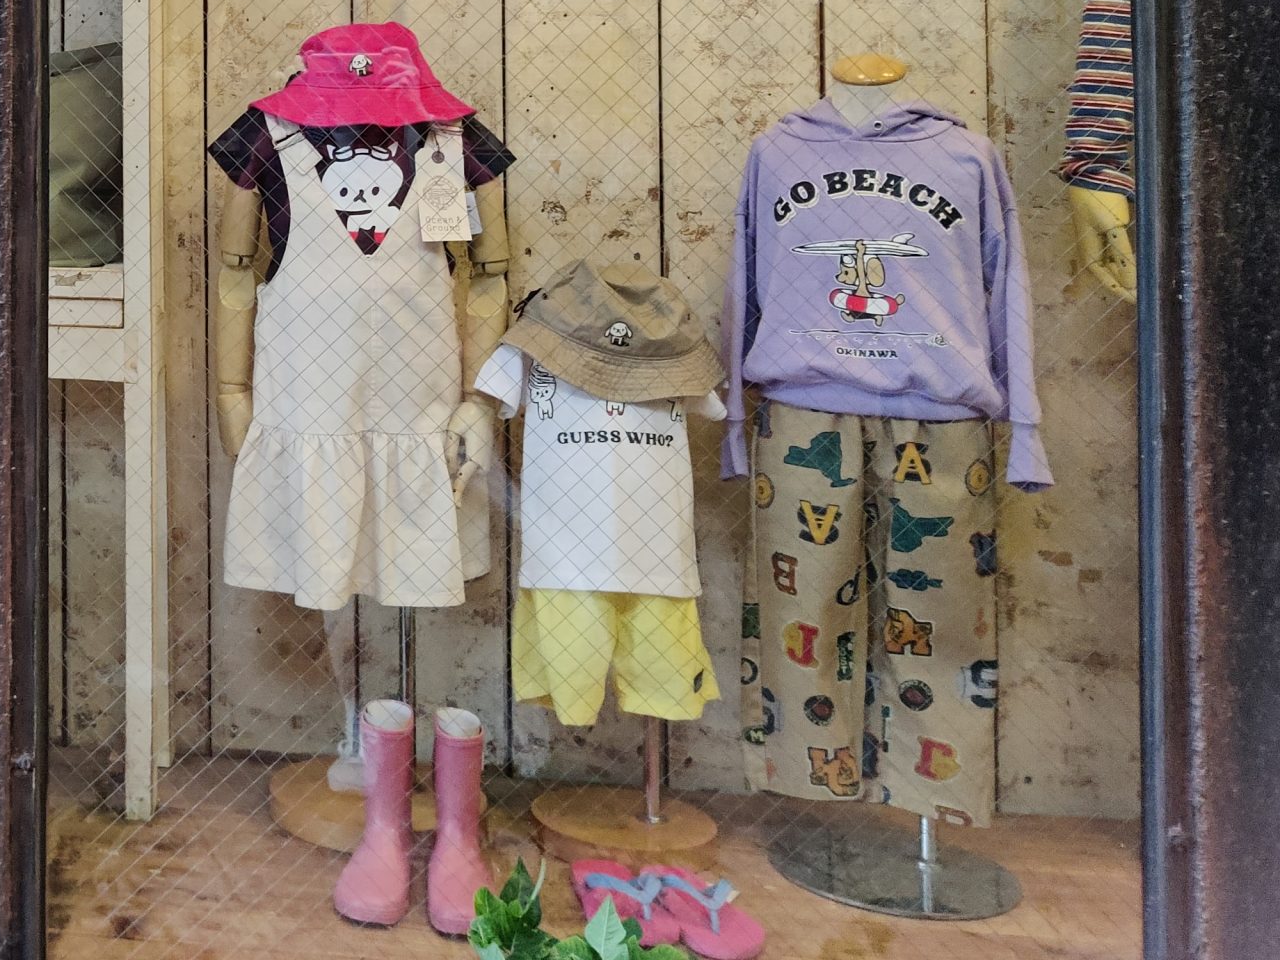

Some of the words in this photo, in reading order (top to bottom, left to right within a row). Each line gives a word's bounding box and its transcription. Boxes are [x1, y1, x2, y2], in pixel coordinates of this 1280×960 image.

[773, 180, 817, 224] GO
[822, 168, 964, 232] BEACH
[425, 215, 454, 224] Ocean
[835, 346, 899, 359] OKINAWA
[557, 430, 622, 445] GUESS
[625, 431, 674, 448] WHO?
